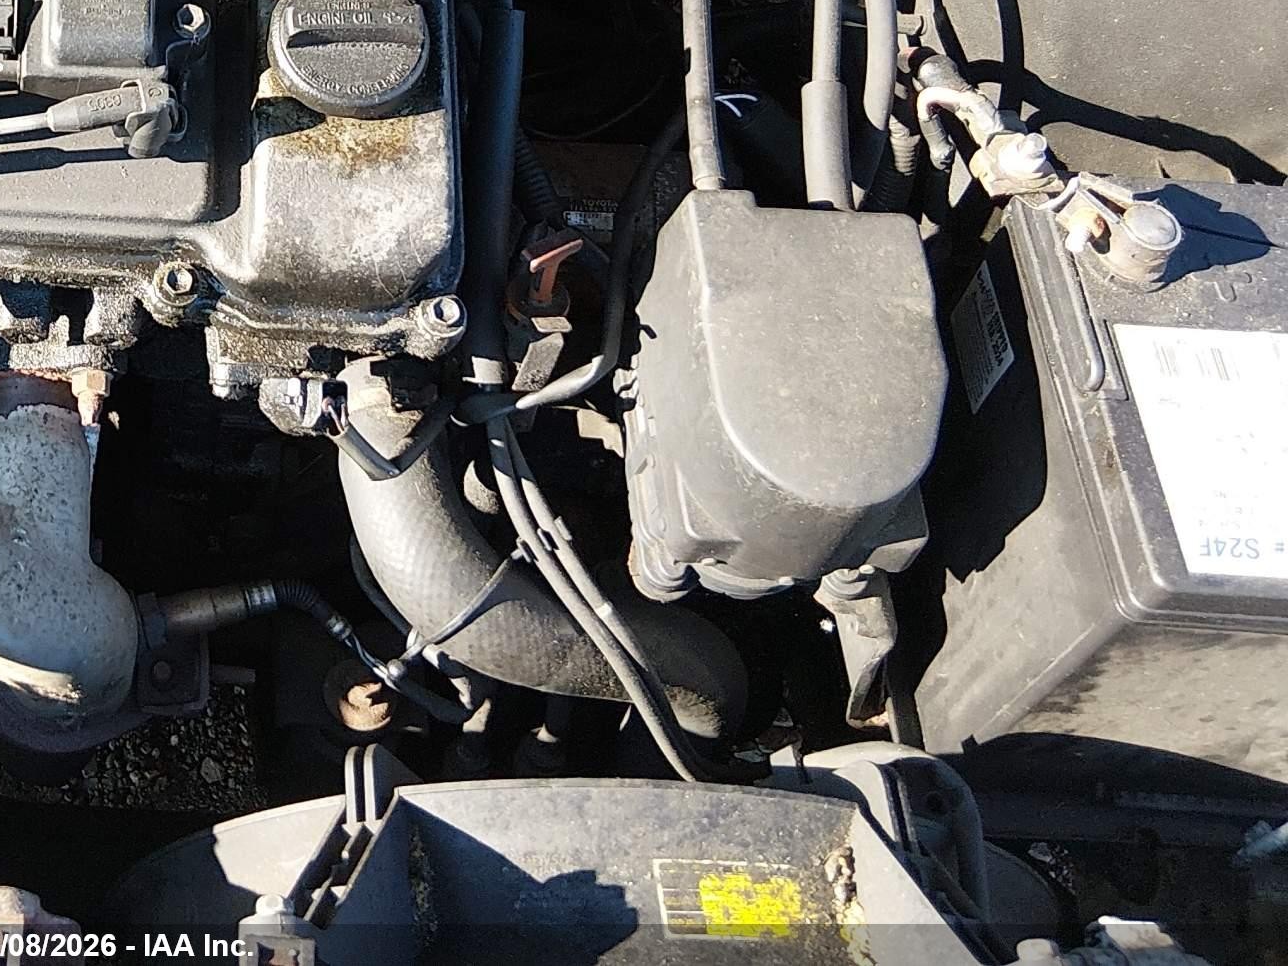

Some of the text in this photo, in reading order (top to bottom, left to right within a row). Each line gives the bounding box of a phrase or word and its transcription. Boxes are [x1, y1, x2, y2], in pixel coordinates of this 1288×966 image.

[297, 12, 376, 26] ENGINE OIL
[301, 63, 410, 95] ENERGY CONSERVING
[582, 198, 619, 207] TOYOTA
[1199, 537, 1260, 560] S24F
